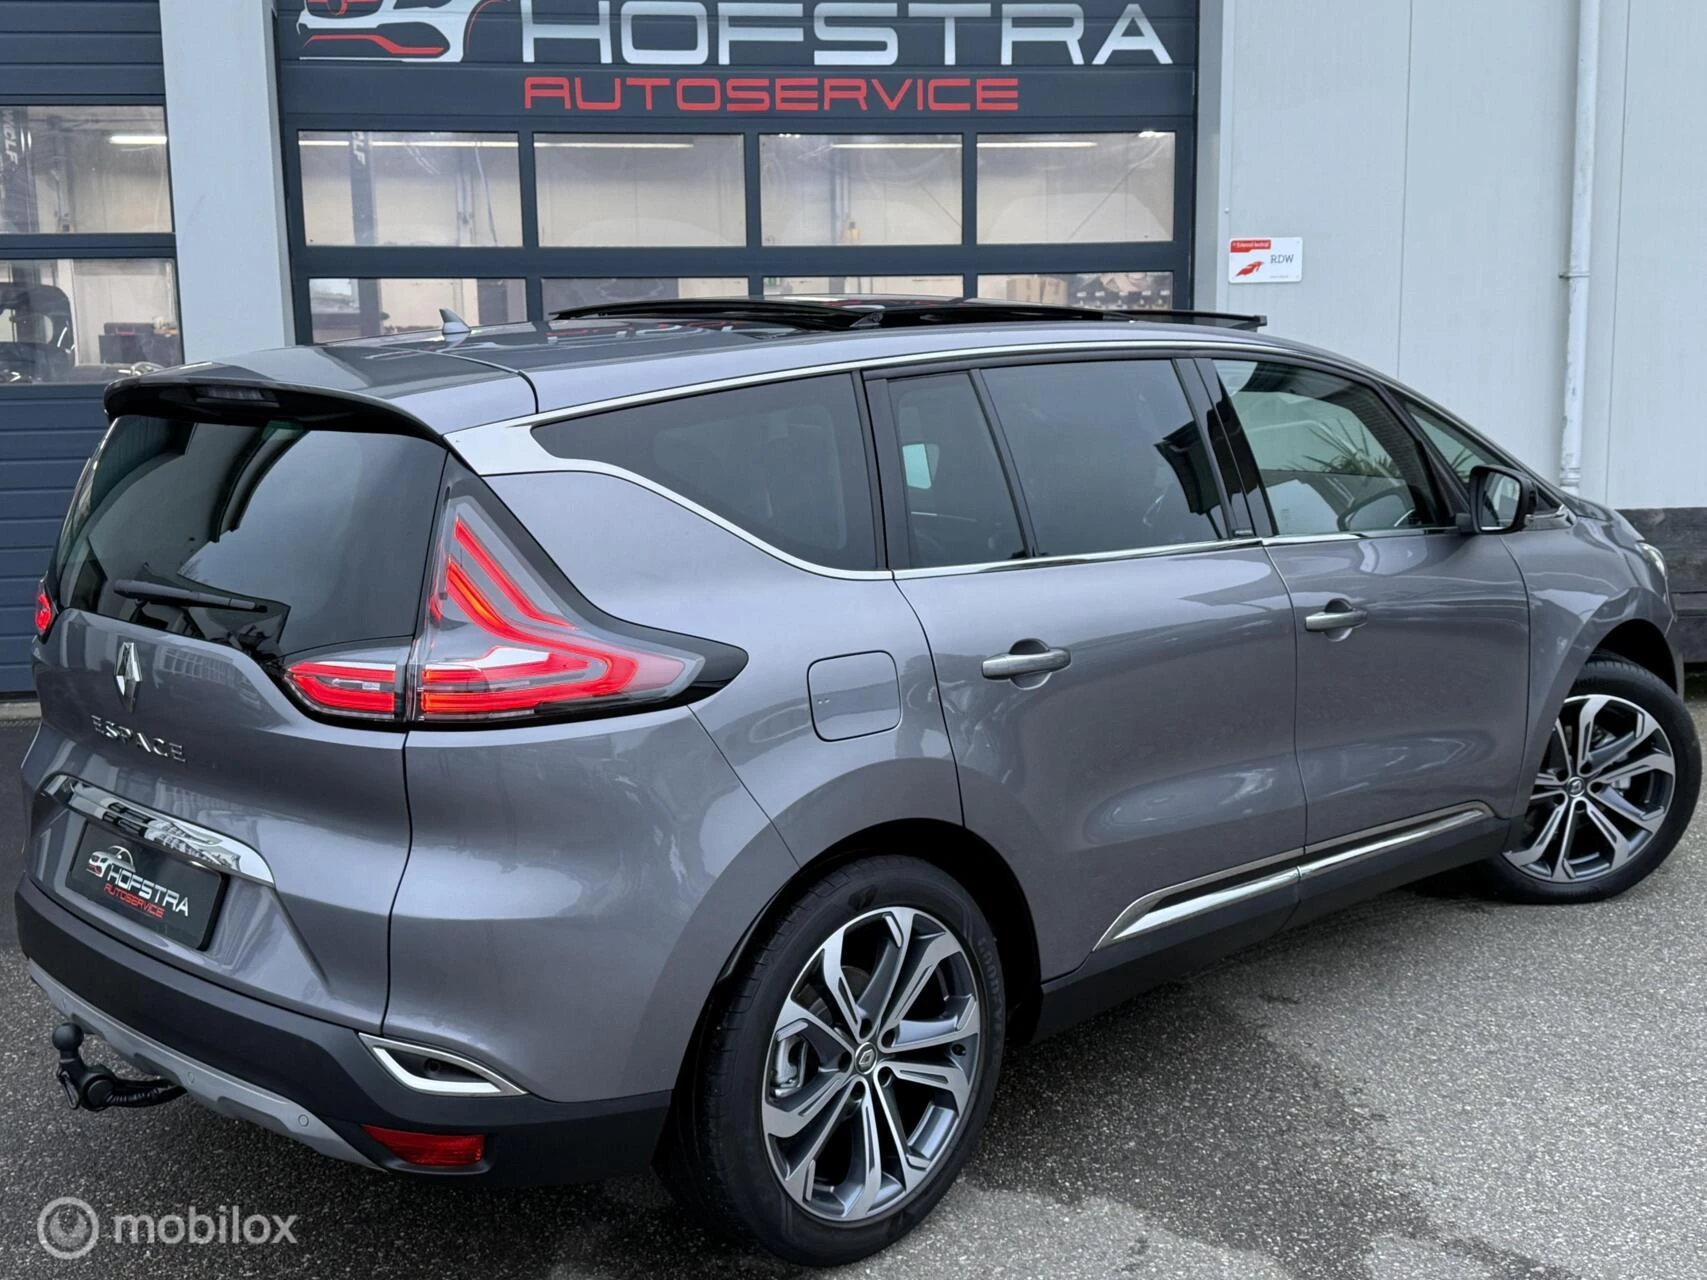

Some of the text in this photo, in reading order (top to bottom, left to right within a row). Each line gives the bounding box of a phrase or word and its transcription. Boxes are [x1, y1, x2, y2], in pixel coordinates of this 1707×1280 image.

[520, 0, 1174, 66] HOFSTRA
[523, 76, 1019, 112] AUTOSERVICE
[1270, 254, 1295, 264] RDW
[91, 715, 186, 763] ESPACE
[104, 882, 165, 919] AUTOSERVICE
[107, 864, 189, 917] HOFSTRA
